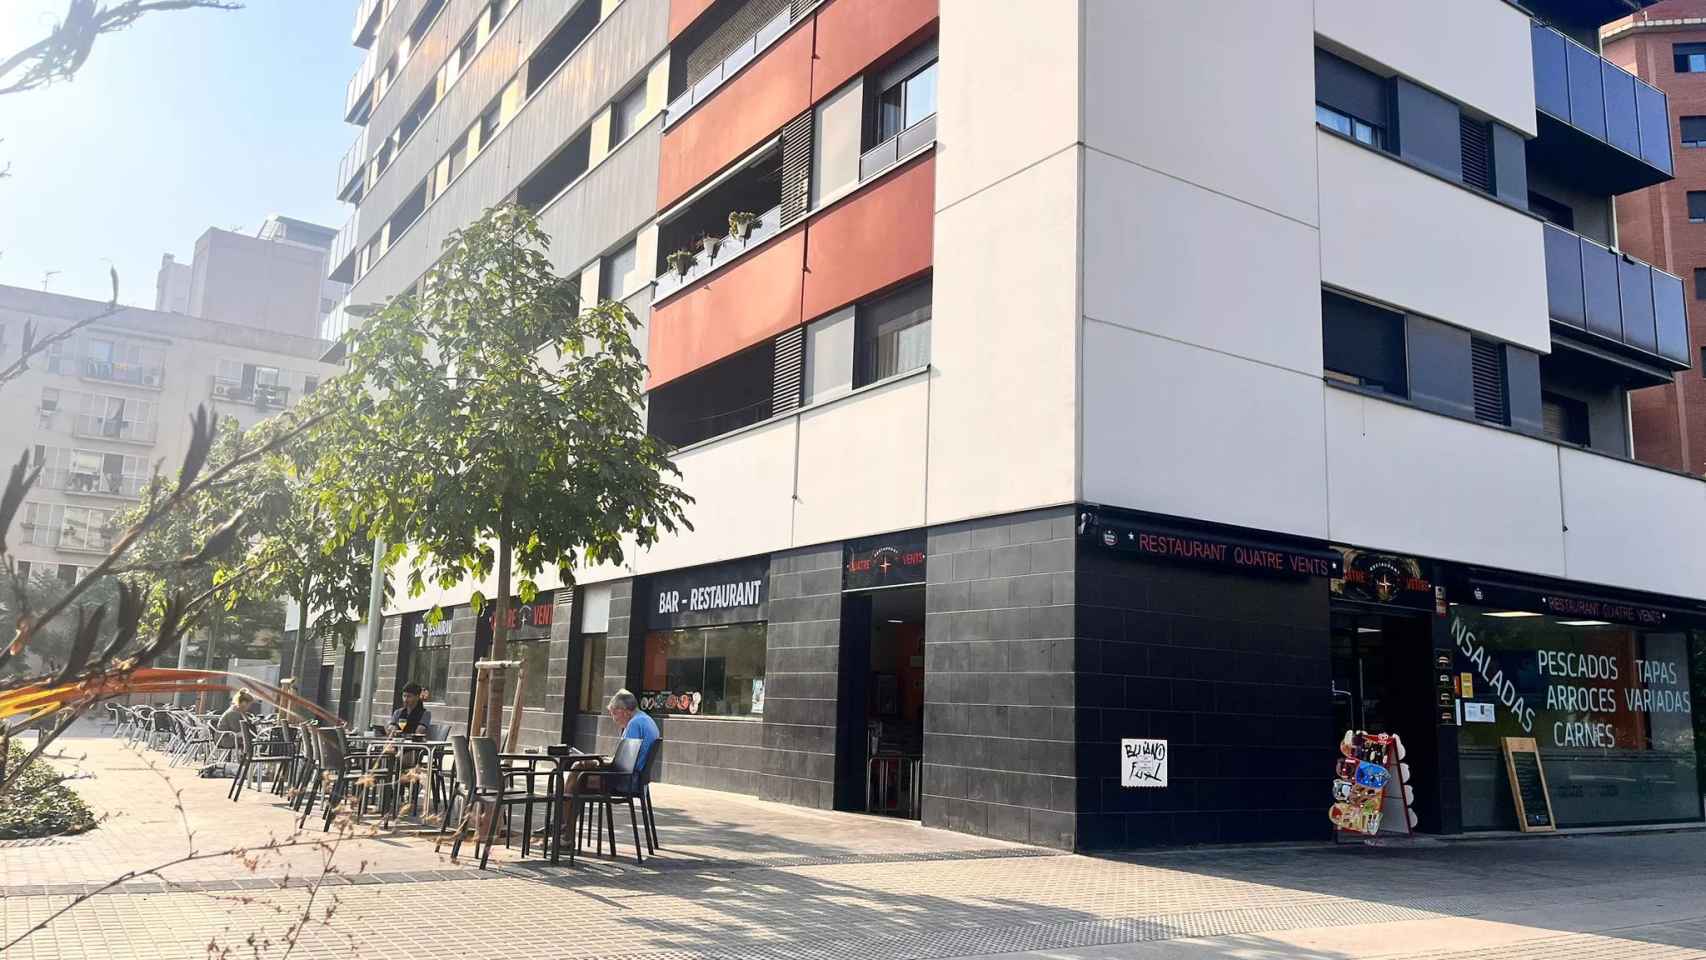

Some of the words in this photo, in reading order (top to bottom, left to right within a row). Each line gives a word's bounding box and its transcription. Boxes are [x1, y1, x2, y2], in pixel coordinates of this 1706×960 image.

[1139, 533, 1227, 561] RESTAURANT
[1234, 547, 1283, 569] QUATRE
[1289, 555, 1329, 575] VENTS
[659, 590, 679, 613] BAR
[690, 580, 762, 611] RESTAURANT
[1450, 616, 1535, 733] NSALADAS
[1538, 650, 1619, 681] PESCADOS
[1635, 659, 1678, 685] TAPAS
[1547, 685, 1617, 713] ARROCES
[1624, 688, 1692, 713] VARIADAS
[1554, 722, 1616, 748] CARNES
